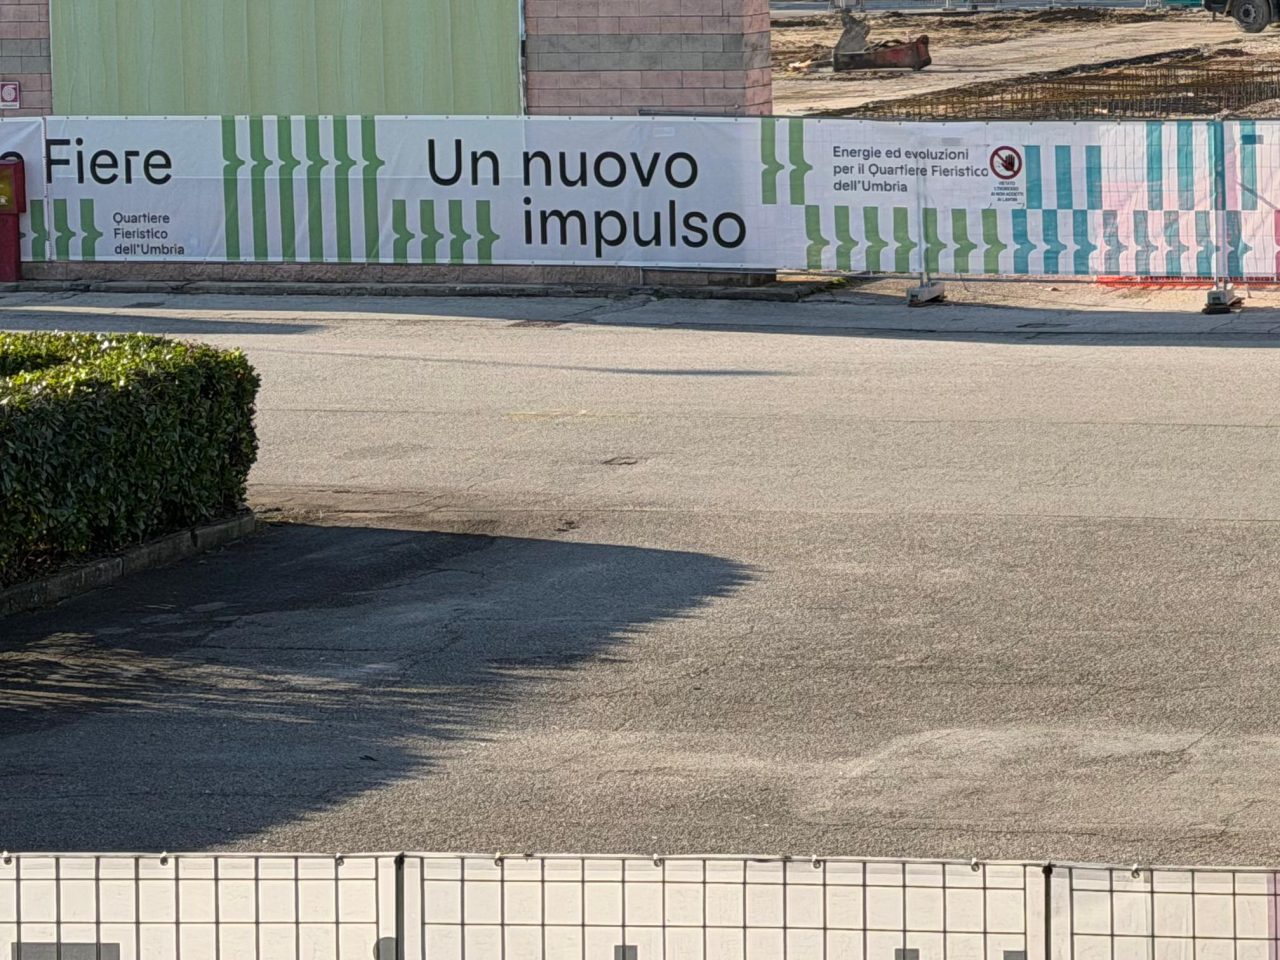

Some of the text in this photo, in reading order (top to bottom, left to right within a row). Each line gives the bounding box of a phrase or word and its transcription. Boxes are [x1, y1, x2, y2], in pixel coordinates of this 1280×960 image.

[833, 146, 969, 160] Energie ed evoluzioni
[46, 138, 172, 185] Fiere
[428, 139, 698, 188] Un nuovo
[833, 163, 989, 177] per il Quartiere Fieristico
[833, 180, 908, 192] dell'Umbria
[112, 212, 171, 226] Quartiere
[113, 228, 169, 240] Fieristico
[523, 196, 747, 258] impulso
[114, 243, 185, 256] dell'Umbria
